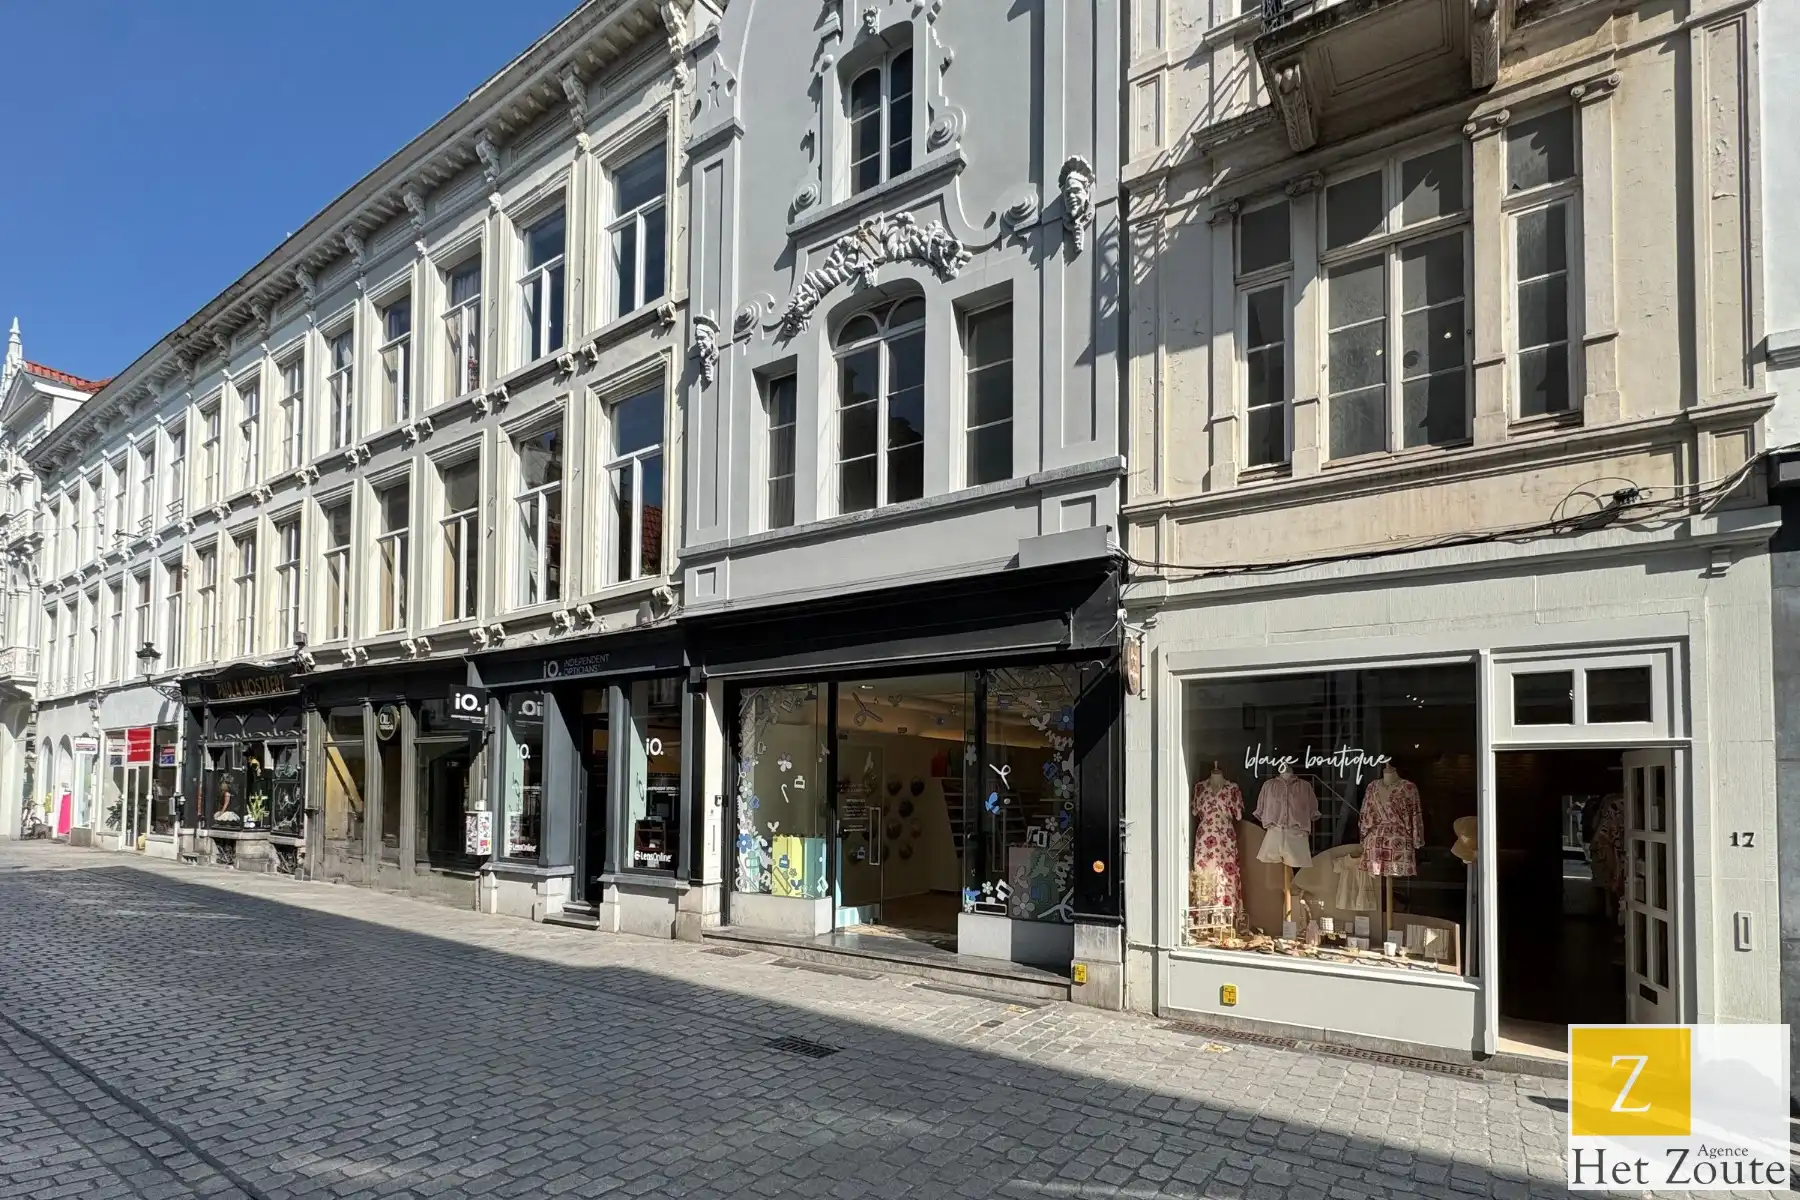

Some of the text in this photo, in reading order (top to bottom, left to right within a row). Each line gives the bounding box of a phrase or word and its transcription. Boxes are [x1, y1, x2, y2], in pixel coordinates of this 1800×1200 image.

[563, 653, 610, 667] INDEPENDENT
[216, 674, 285, 698] PAULA MOSTAERT
[455, 692, 482, 712] iO.
[517, 743, 531, 759] iO.
[645, 737, 664, 756] iO.
[1244, 743, 1392, 785] blaise boutique
[1729, 831, 1755, 847] 17
[640, 851, 672, 862] LensOnline
